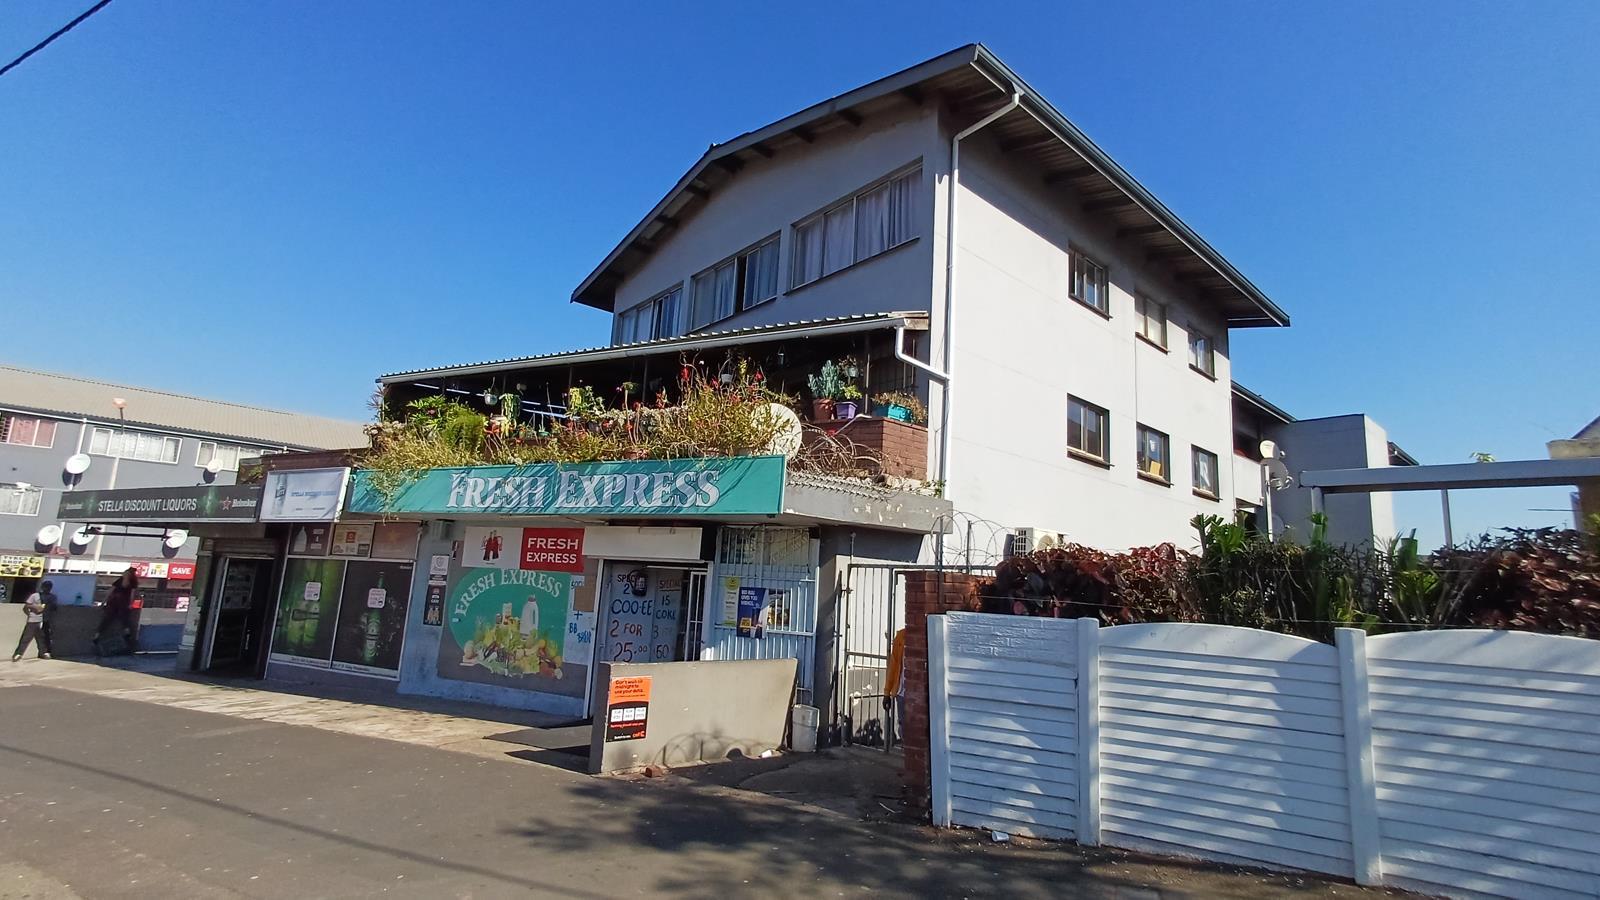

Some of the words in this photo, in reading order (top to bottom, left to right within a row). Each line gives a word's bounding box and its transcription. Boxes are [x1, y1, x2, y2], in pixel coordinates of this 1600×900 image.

[446, 473, 549, 508] FRESH
[554, 470, 720, 508] EXPRESS
[98, 500, 123, 512] STELLA
[124, 499, 161, 511] DISCOUNT
[162, 498, 197, 511] LIQUORS
[527, 537, 579, 550] FRESH
[526, 552, 577, 564] EXPRESS
[171, 567, 192, 575] SAVE
[455, 572, 496, 616] FRESH
[501, 569, 563, 598] EXPRESS
[610, 620, 619, 637] 2
[624, 623, 642, 636] FOR
